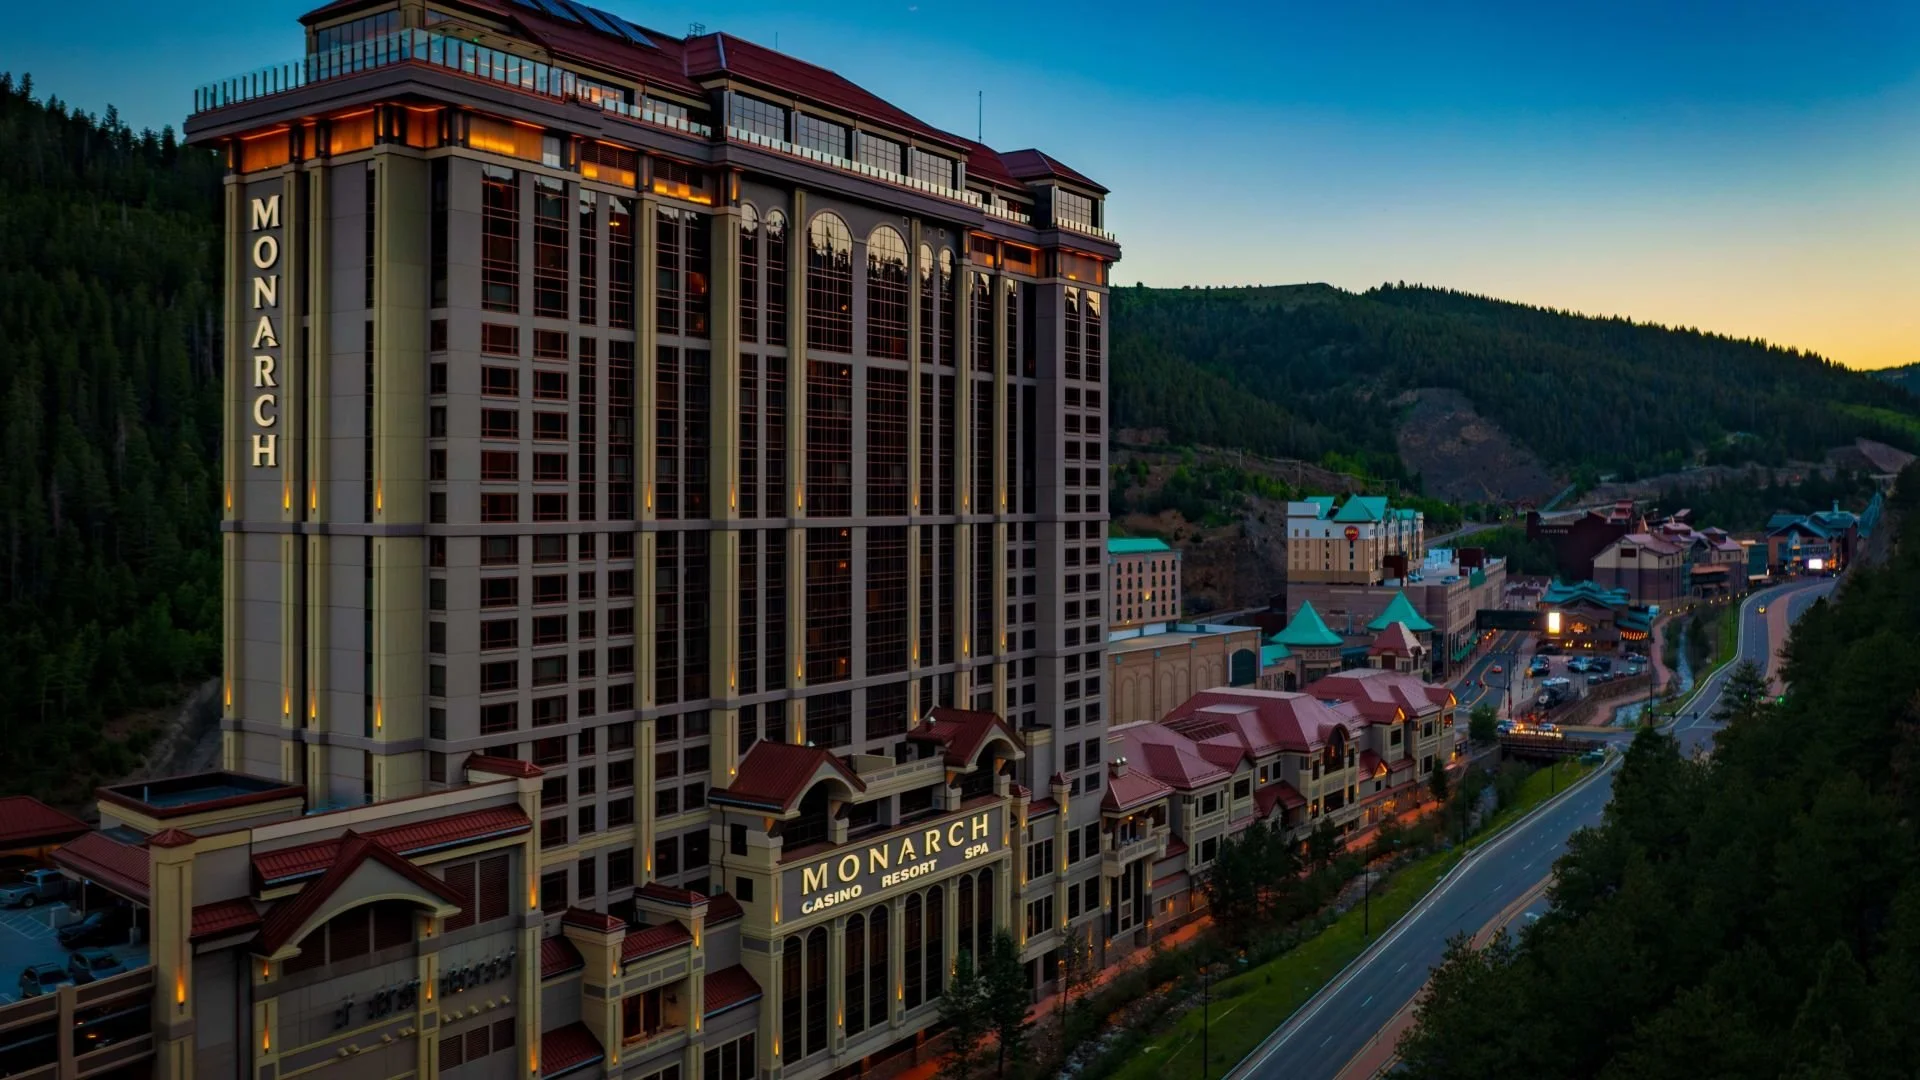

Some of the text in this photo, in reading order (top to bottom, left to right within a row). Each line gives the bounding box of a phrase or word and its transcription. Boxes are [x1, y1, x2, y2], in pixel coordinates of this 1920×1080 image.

[252, 195, 281, 467] MONARCH
[801, 842, 989, 915] CASINO RESORT SPA
[802, 813, 989, 896] MONARCH
